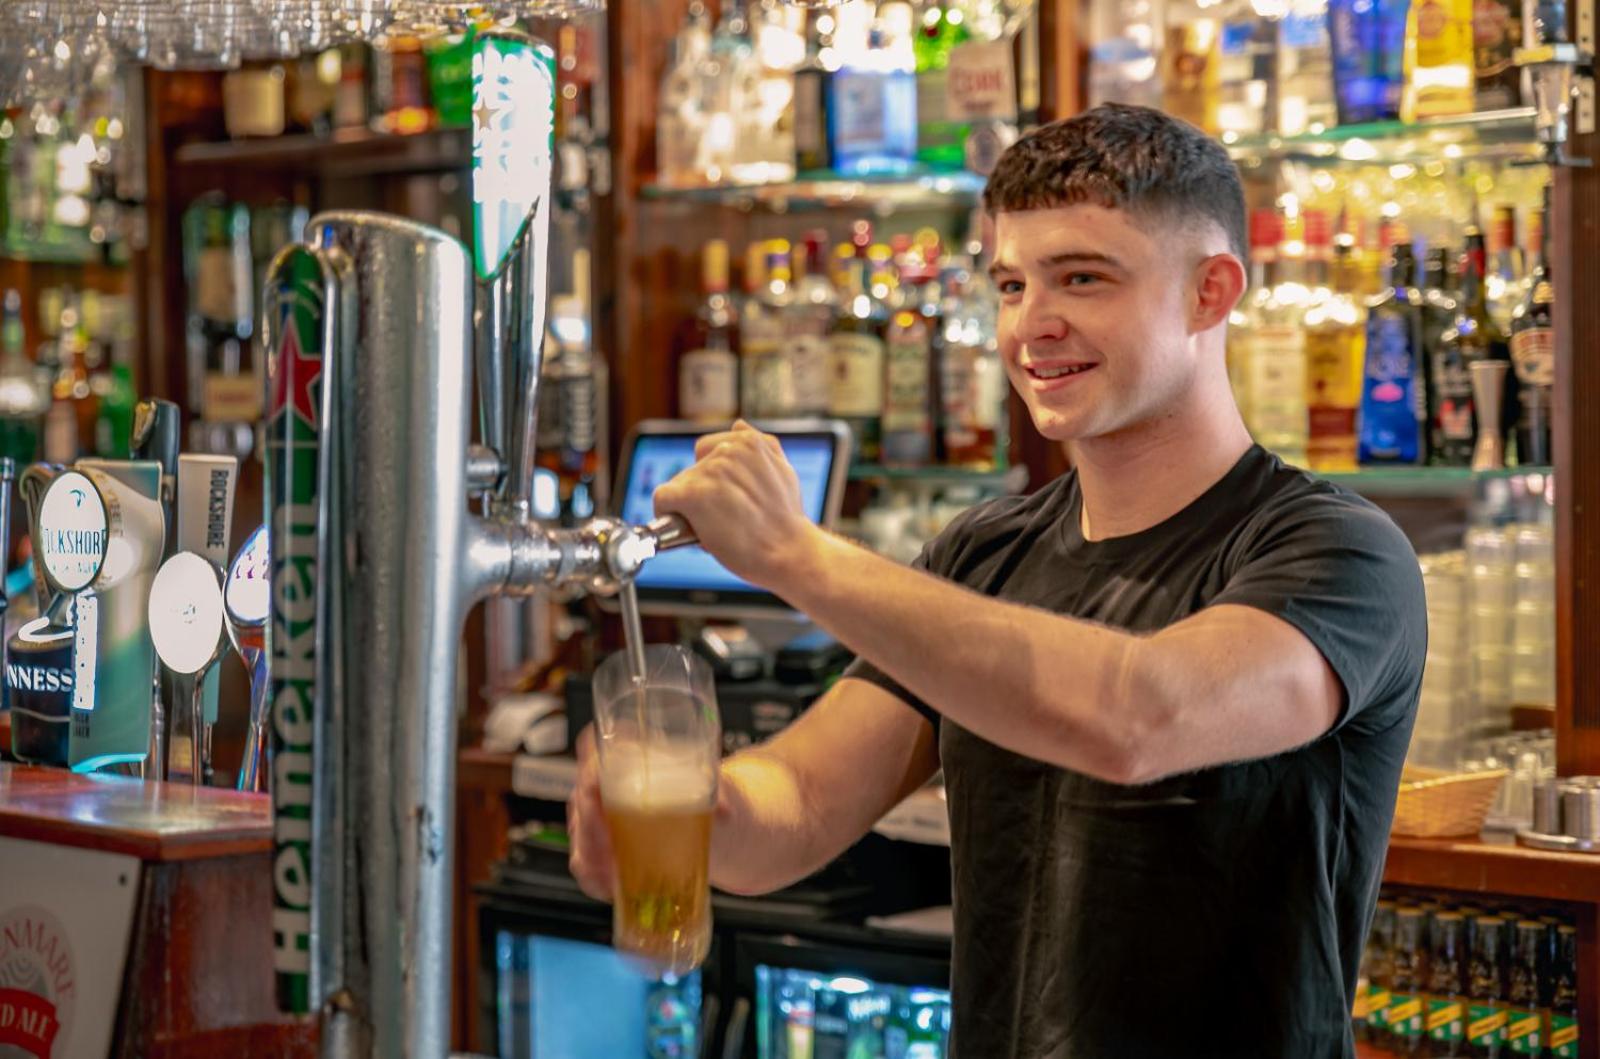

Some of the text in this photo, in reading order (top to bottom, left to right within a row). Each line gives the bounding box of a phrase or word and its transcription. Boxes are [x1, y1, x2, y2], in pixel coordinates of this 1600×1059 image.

[206, 470, 229, 549] ROCKSHORE
[7, 664, 73, 693] NNESS
[272, 498, 317, 973] Heineken
